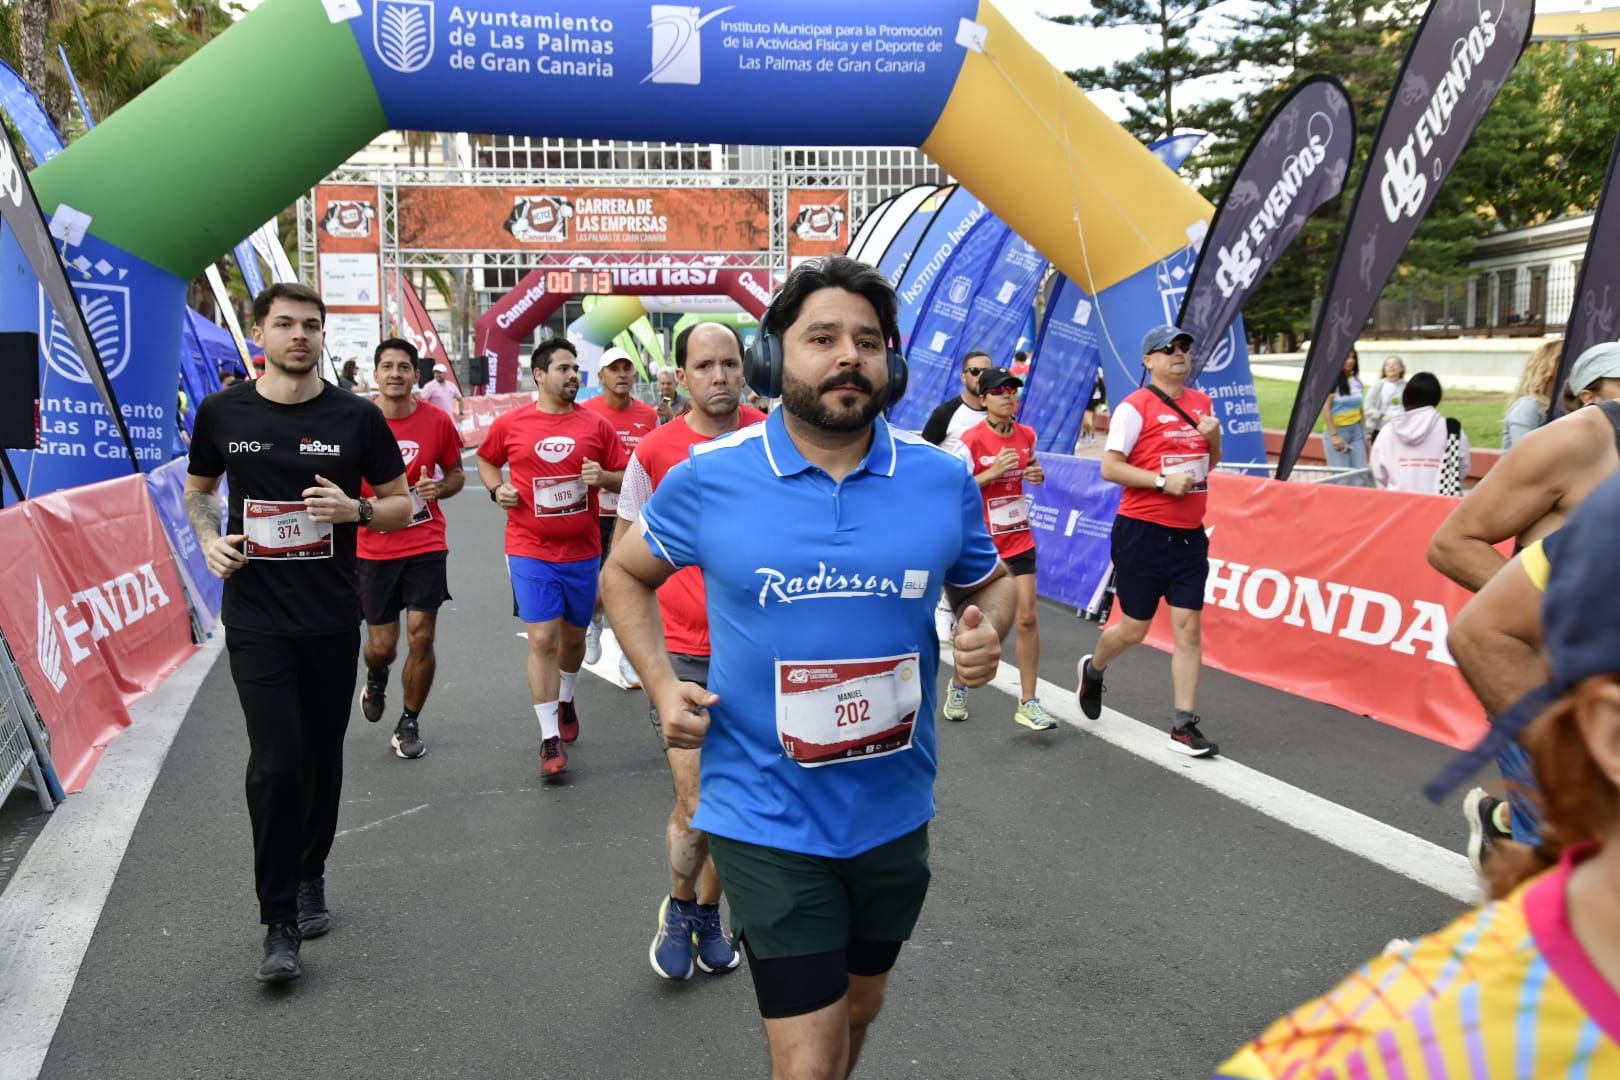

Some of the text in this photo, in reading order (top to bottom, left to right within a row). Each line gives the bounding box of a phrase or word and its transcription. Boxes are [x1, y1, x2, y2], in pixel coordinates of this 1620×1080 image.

[449, 6, 613, 32] Ayuntamiento
[721, 20, 943, 38] Instituto Municipal para la Promoción
[449, 27, 613, 55] de Las Palmas
[723, 36, 739, 48] de
[743, 36, 754, 49] la
[756, 36, 812, 51] Actividad
[850, 41, 860, 55] y
[862, 39, 872, 52] el
[876, 40, 923, 55] Deporte
[927, 40, 943, 52] de
[449, 50, 613, 77] de Gran Canaria
[739, 55, 925, 73] Las Palmas de Gran Canaria
[1381, 10, 1496, 223] dg EVENTOS
[576, 199, 653, 214] CARRERA DE
[1216, 135, 1325, 298] dg EVENTOS
[576, 216, 667, 232] LAS EMPRESAS
[902, 244, 952, 304] INSTITUTO
[496, 275, 545, 328] Canarias
[40, 397, 164, 419] ntamento
[42, 416, 163, 439] Las Pamas
[229, 441, 261, 453] DAG
[537, 442, 576, 453] ICOT
[277, 524, 301, 539] 374
[755, 561, 899, 608] Radisson
[1203, 557, 1457, 667] HONDA
[837, 689, 863, 701] MANUEL
[835, 699, 871, 727] 202
